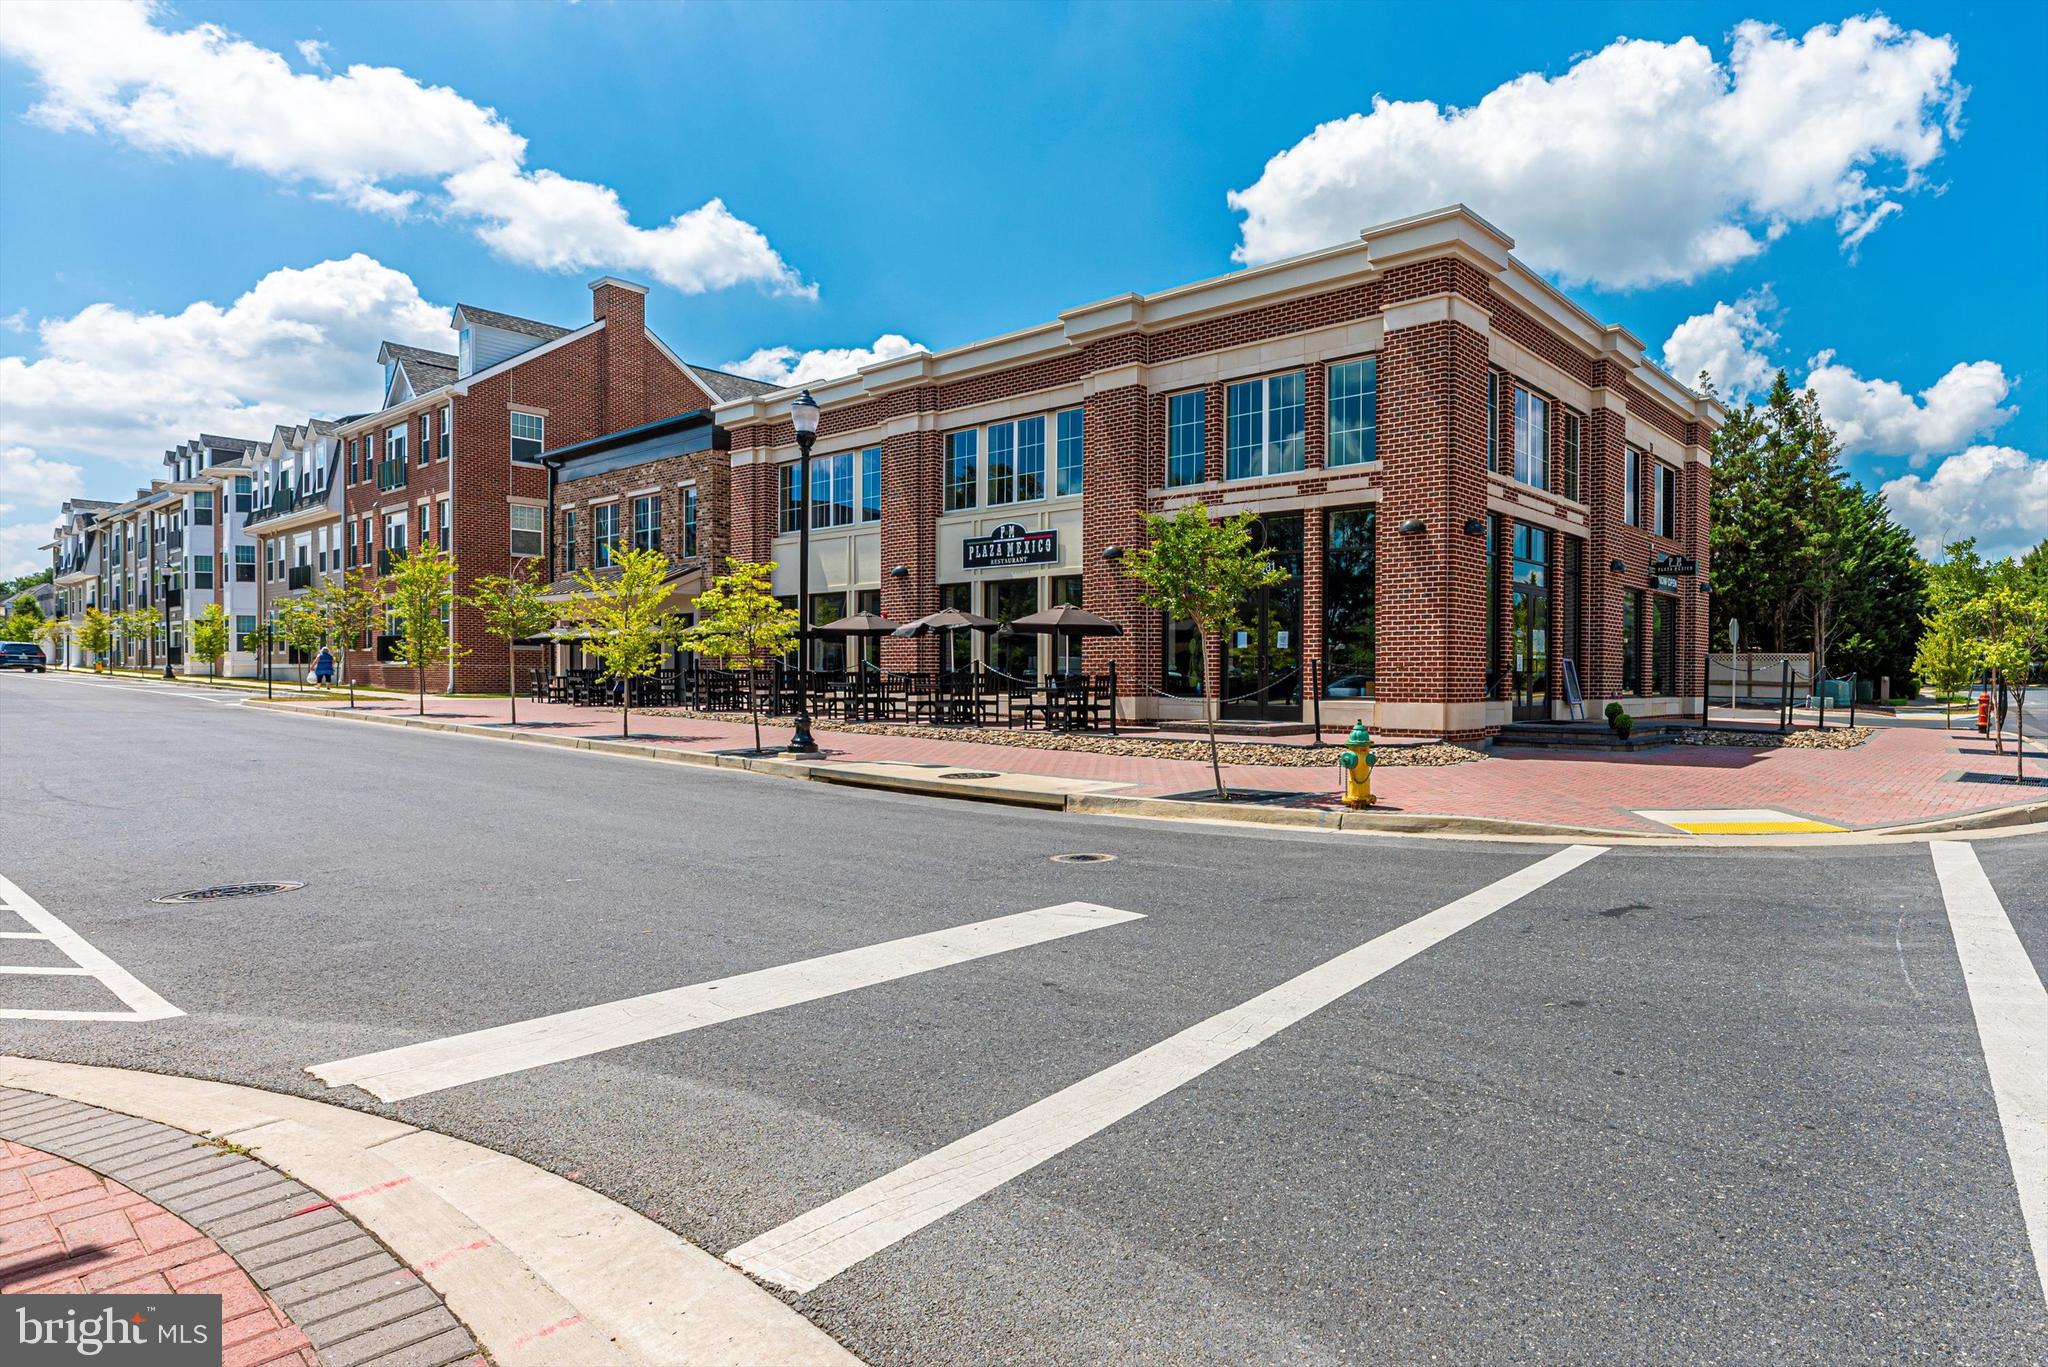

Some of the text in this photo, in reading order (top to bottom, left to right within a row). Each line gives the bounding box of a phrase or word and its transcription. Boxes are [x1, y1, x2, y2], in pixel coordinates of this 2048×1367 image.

[969, 538, 1051, 560] PLAZA MEXICO
[990, 556, 1028, 565] RESTAURANT
